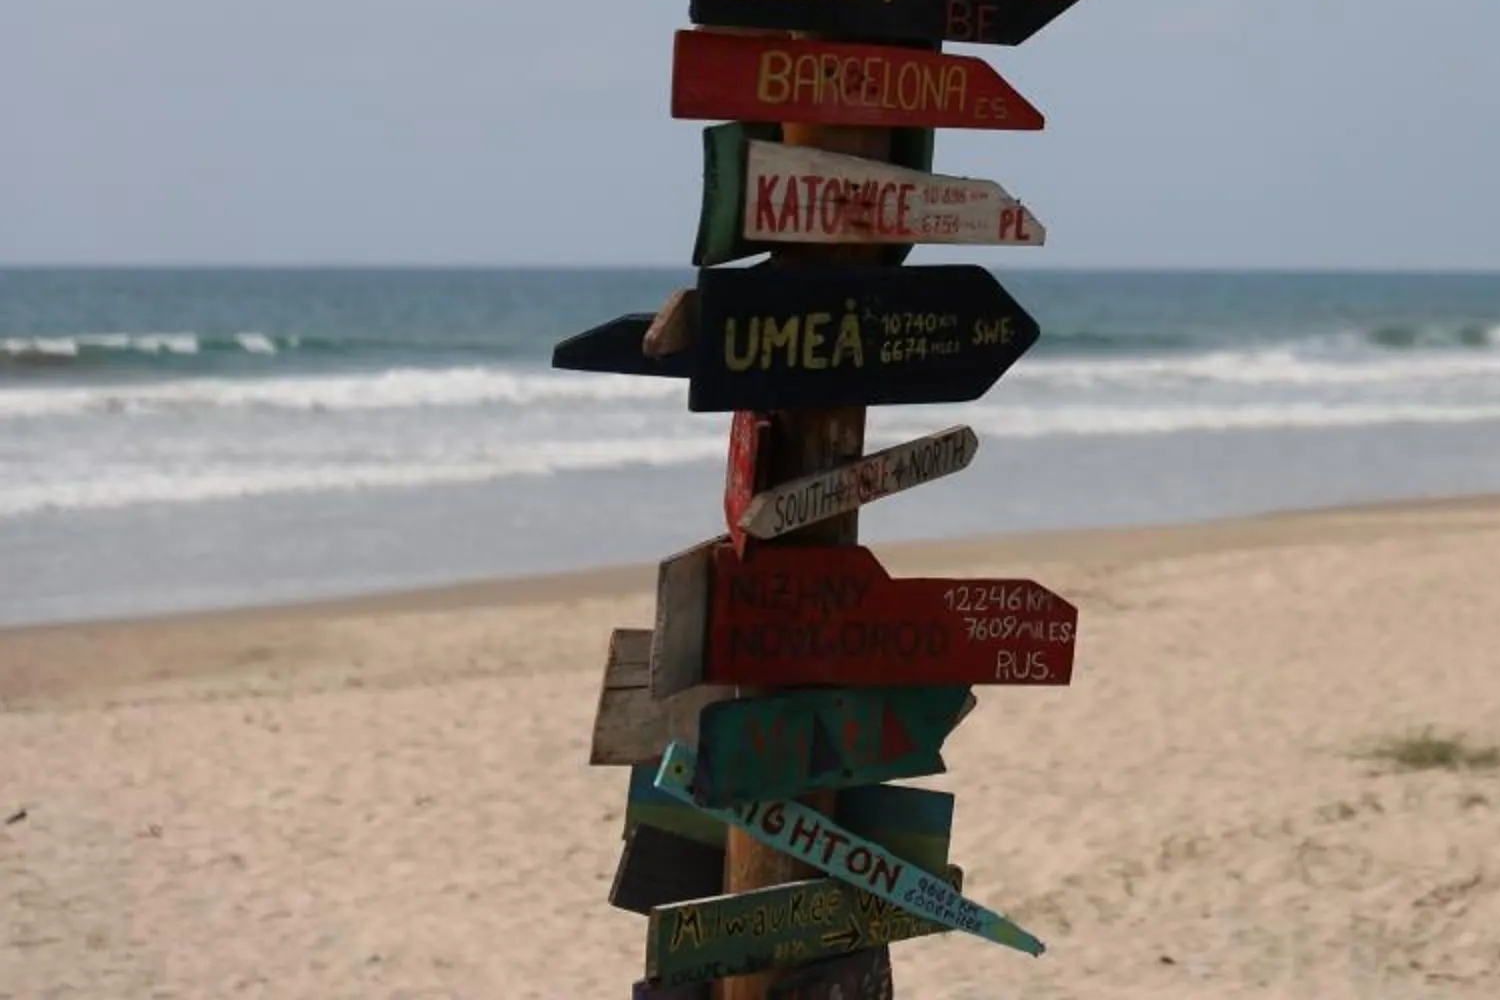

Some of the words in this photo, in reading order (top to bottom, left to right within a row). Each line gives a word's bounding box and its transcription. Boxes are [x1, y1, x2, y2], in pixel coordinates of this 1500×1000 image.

[757, 49, 968, 114] BARCELONA
[998, 206, 1031, 241] PL
[723, 296, 865, 373] UMEÅ
[944, 585, 1023, 612] 12246
[963, 615, 1017, 643] 7609
[735, 799, 903, 895] IGHTON
